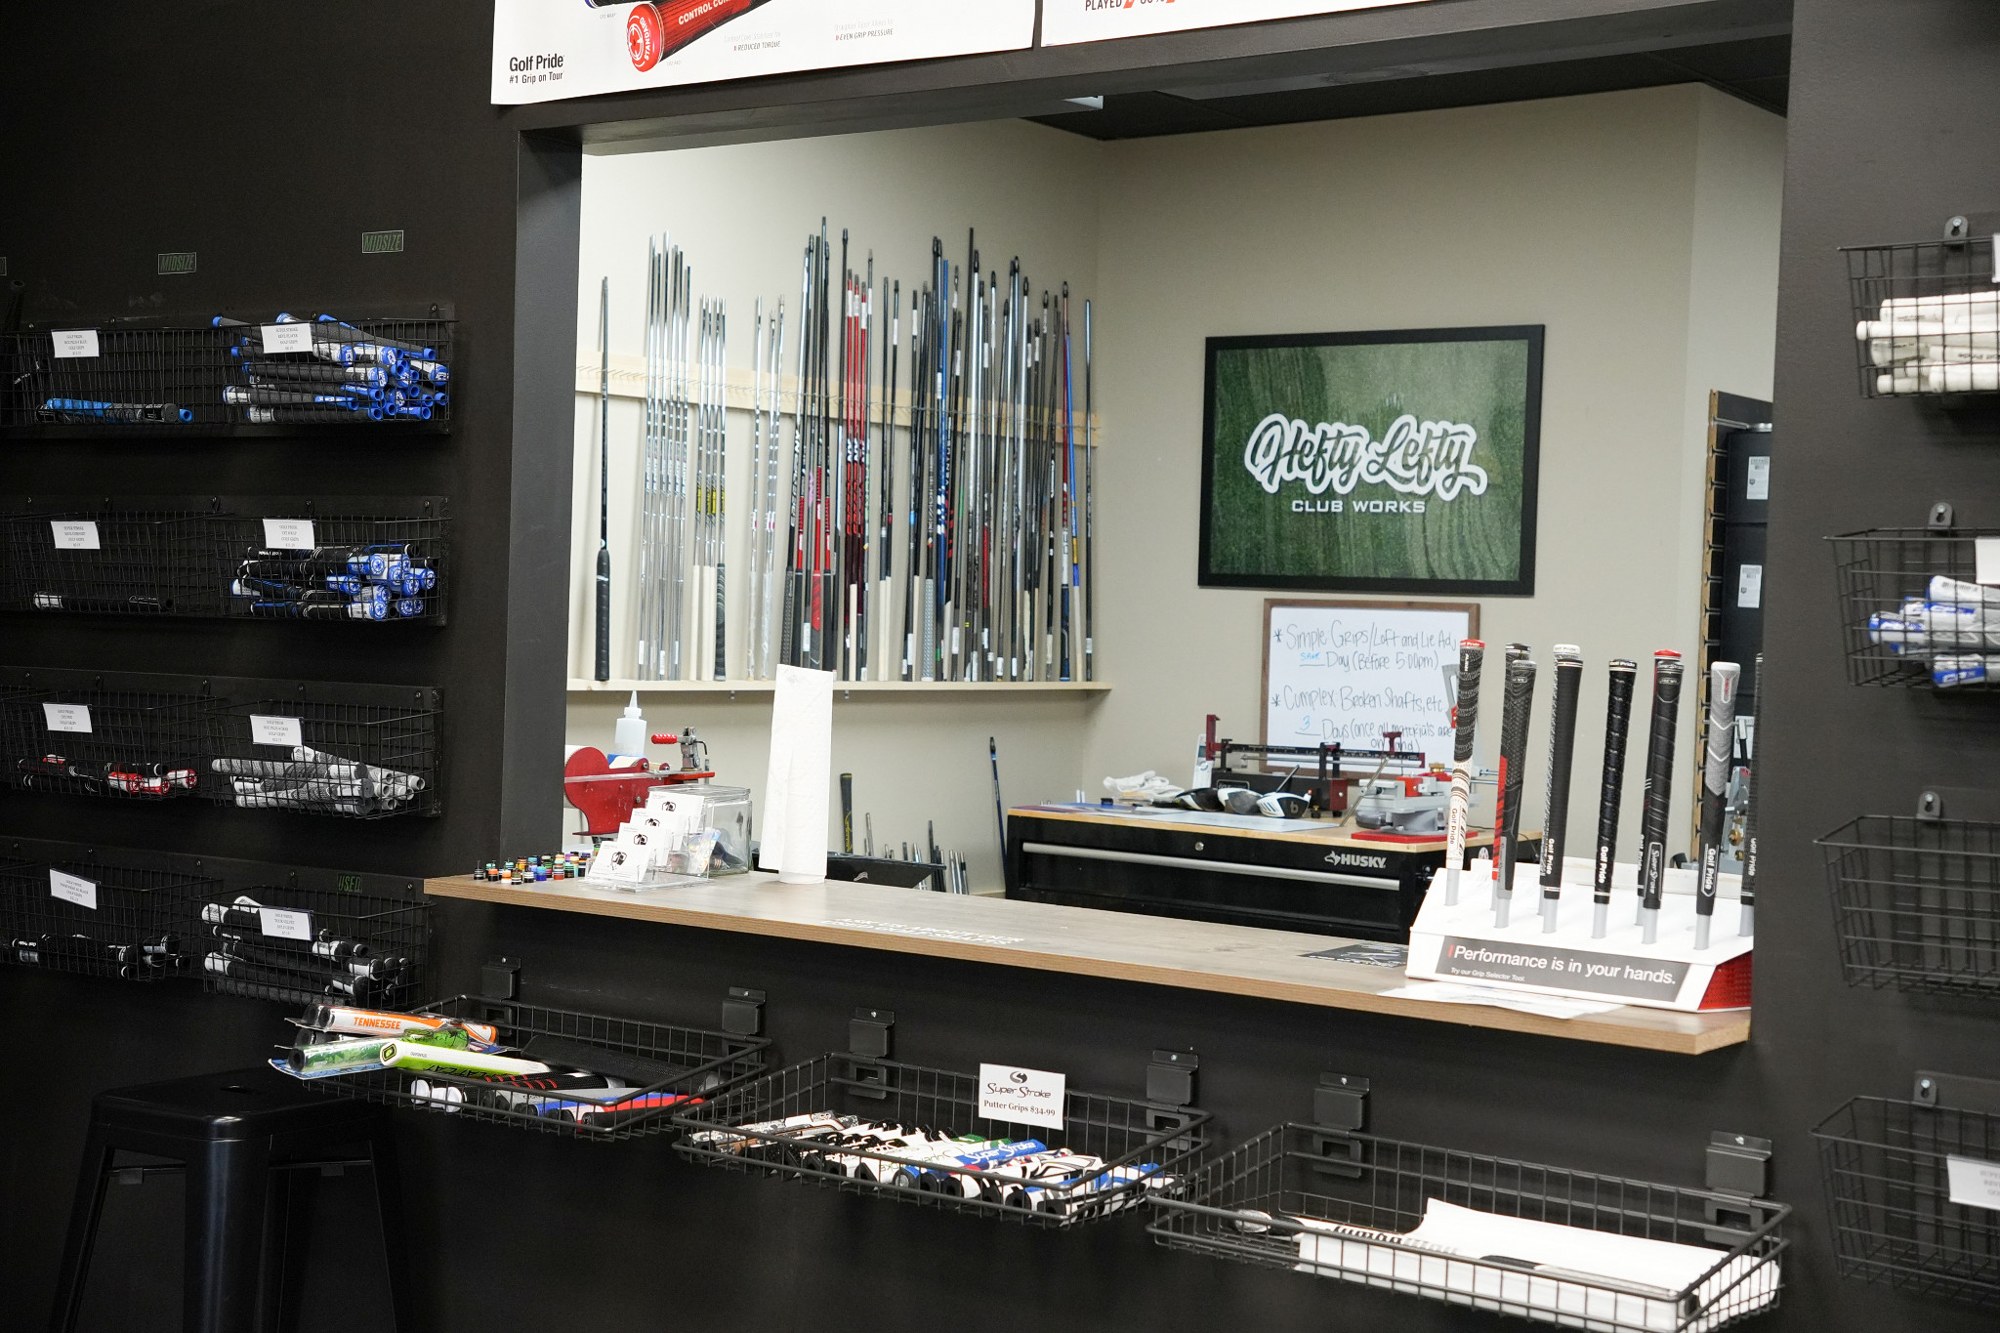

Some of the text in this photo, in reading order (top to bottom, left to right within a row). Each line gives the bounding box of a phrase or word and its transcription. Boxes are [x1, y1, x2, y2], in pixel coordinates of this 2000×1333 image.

[678, 2, 713, 25] CONTROL
[1086, 0, 1122, 11] PLAYED
[639, 17, 650, 61] STANDARD
[839, 32, 853, 41] EVEN
[854, 31, 866, 39] GRIP
[737, 42, 761, 51] REDUCED
[509, 53, 564, 72] Golf Pride
[509, 72, 563, 85] #1 Grip on Tour
[363, 234, 401, 252] MIDSIZE
[160, 254, 195, 272] MIDSIZE
[1245, 413, 1488, 501] Hefty Lefty
[1292, 500, 1426, 513] CLUB WORKS
[1286, 623, 1327, 650] Simple
[1401, 632, 1418, 650] and
[1420, 632, 1435, 648] Lie
[1326, 652, 1350, 672] Day
[1340, 685, 1382, 711] Broken
[1302, 715, 1311, 730] 3
[1322, 719, 1350, 740] Days
[1340, 853, 1387, 869] HUSKY
[1546, 855, 1554, 875] Pride
[1598, 846, 1608, 884] Golf Pride
[1705, 848, 1716, 890] Golf Pride
[1748, 855, 1756, 876] Pride
[1450, 967, 1461, 976] Try
[1472, 970, 1485, 979] Grip
[1486, 971, 1511, 981] Selector
[1454, 945, 1676, 985] Performance is in your hands.
[353, 1016, 401, 1030] TENNESSEE
[985, 1082, 1052, 1098] Super Stroke
[984, 1099, 1007, 1109] Putter
[1008, 1103, 1028, 1113] Grips
[964, 1139, 1037, 1165] Super Stroke
